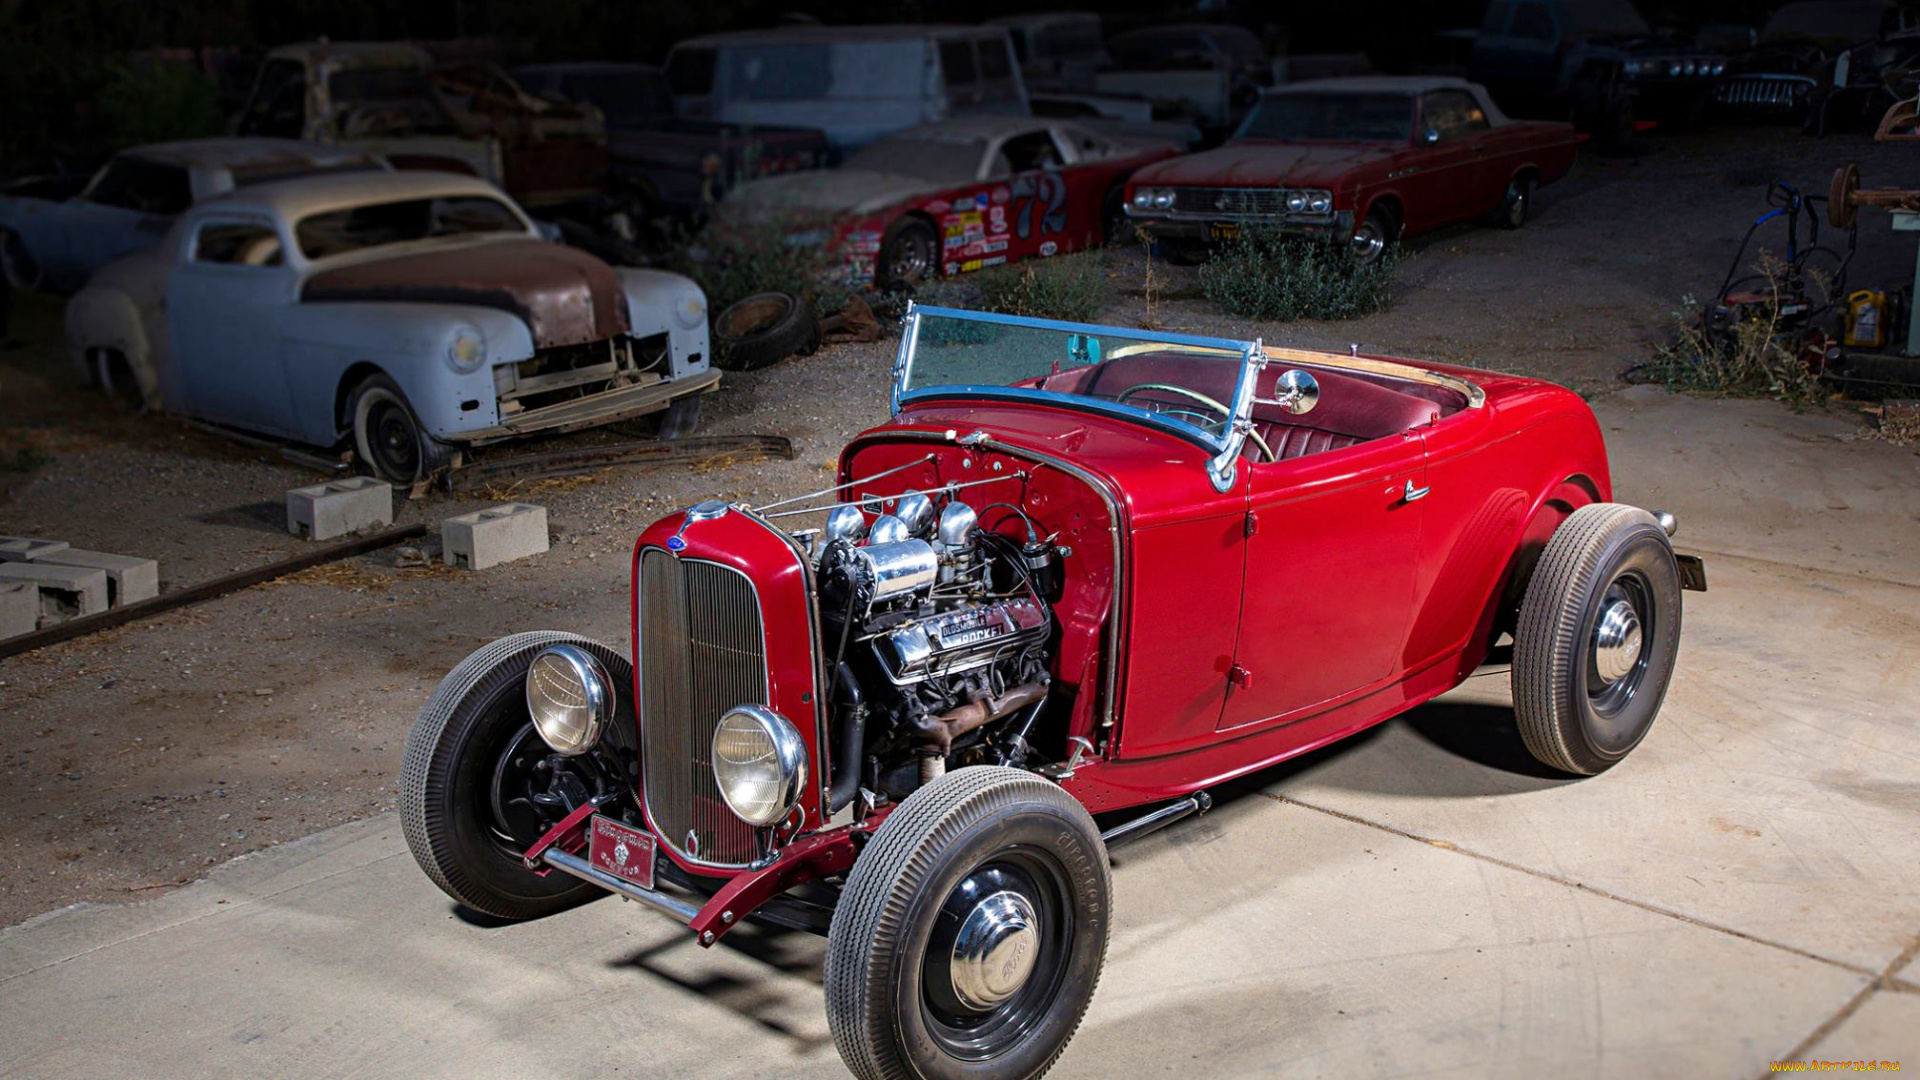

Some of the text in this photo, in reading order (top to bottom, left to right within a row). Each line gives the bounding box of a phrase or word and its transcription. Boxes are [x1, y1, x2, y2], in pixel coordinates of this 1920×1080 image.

[1009, 172, 1067, 240] 72
[943, 616, 986, 637] OLDSMOBILE
[961, 624, 1003, 643] ROCKET
